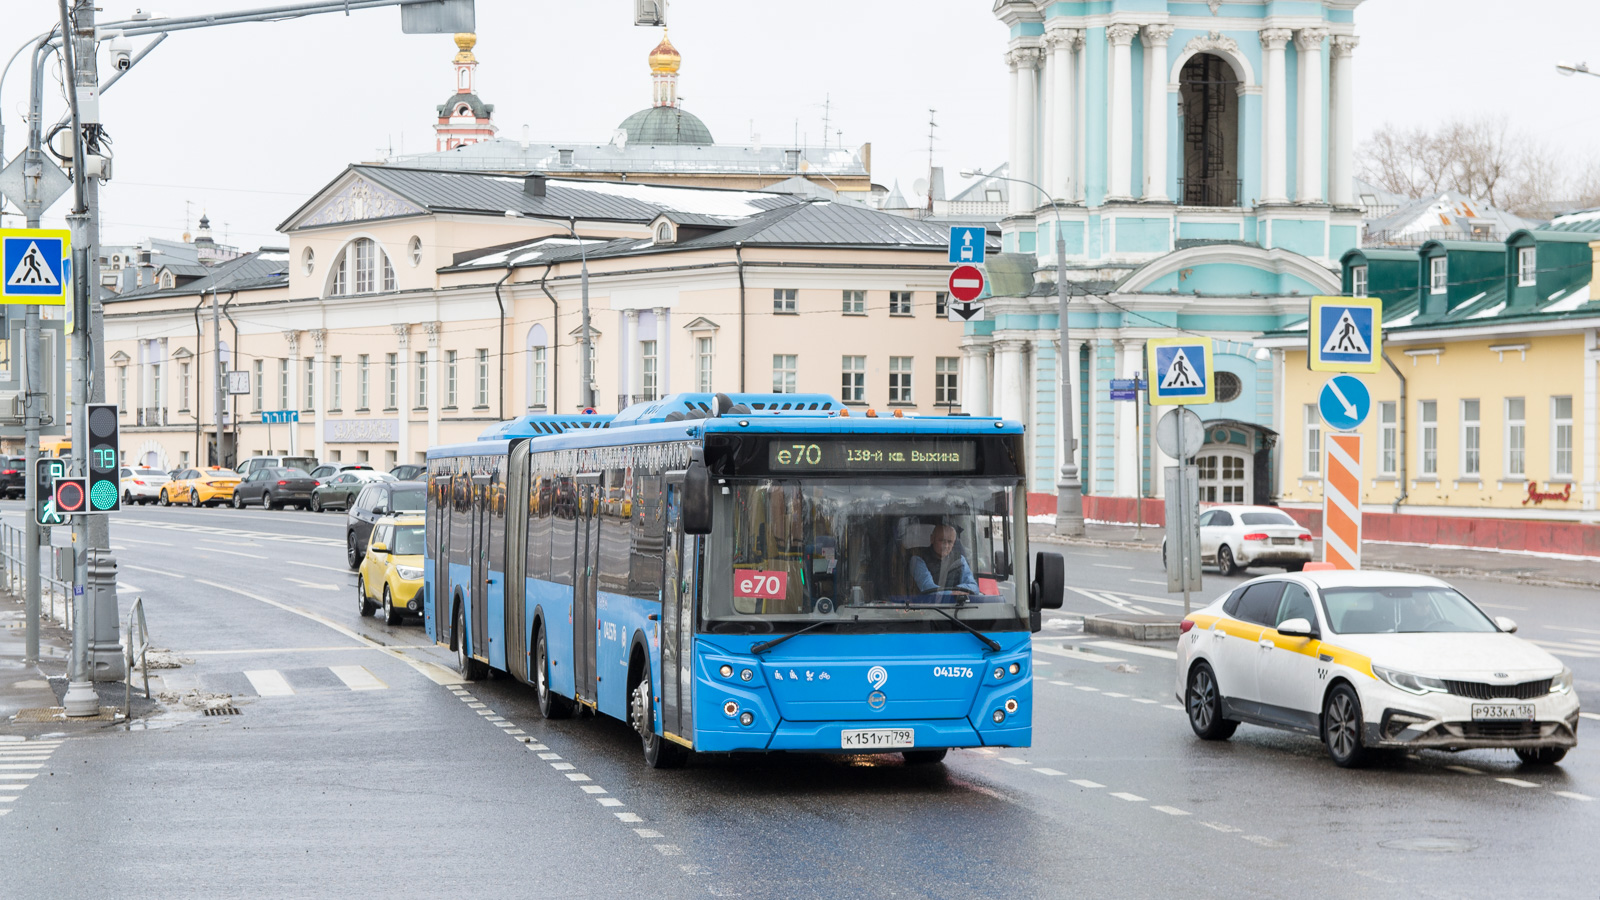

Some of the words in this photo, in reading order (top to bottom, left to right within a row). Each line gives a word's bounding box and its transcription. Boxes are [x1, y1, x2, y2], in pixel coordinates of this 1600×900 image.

[93, 449, 115, 469] 79
[847, 449, 883, 462] 138-й
[888, 451, 906, 462] кв.
[911, 450, 960, 462] Выхина
[740, 575, 781, 595] е70
[933, 666, 974, 678] 041576
[846, 732, 891, 745] К151УТ
[893, 731, 910, 741] 799
